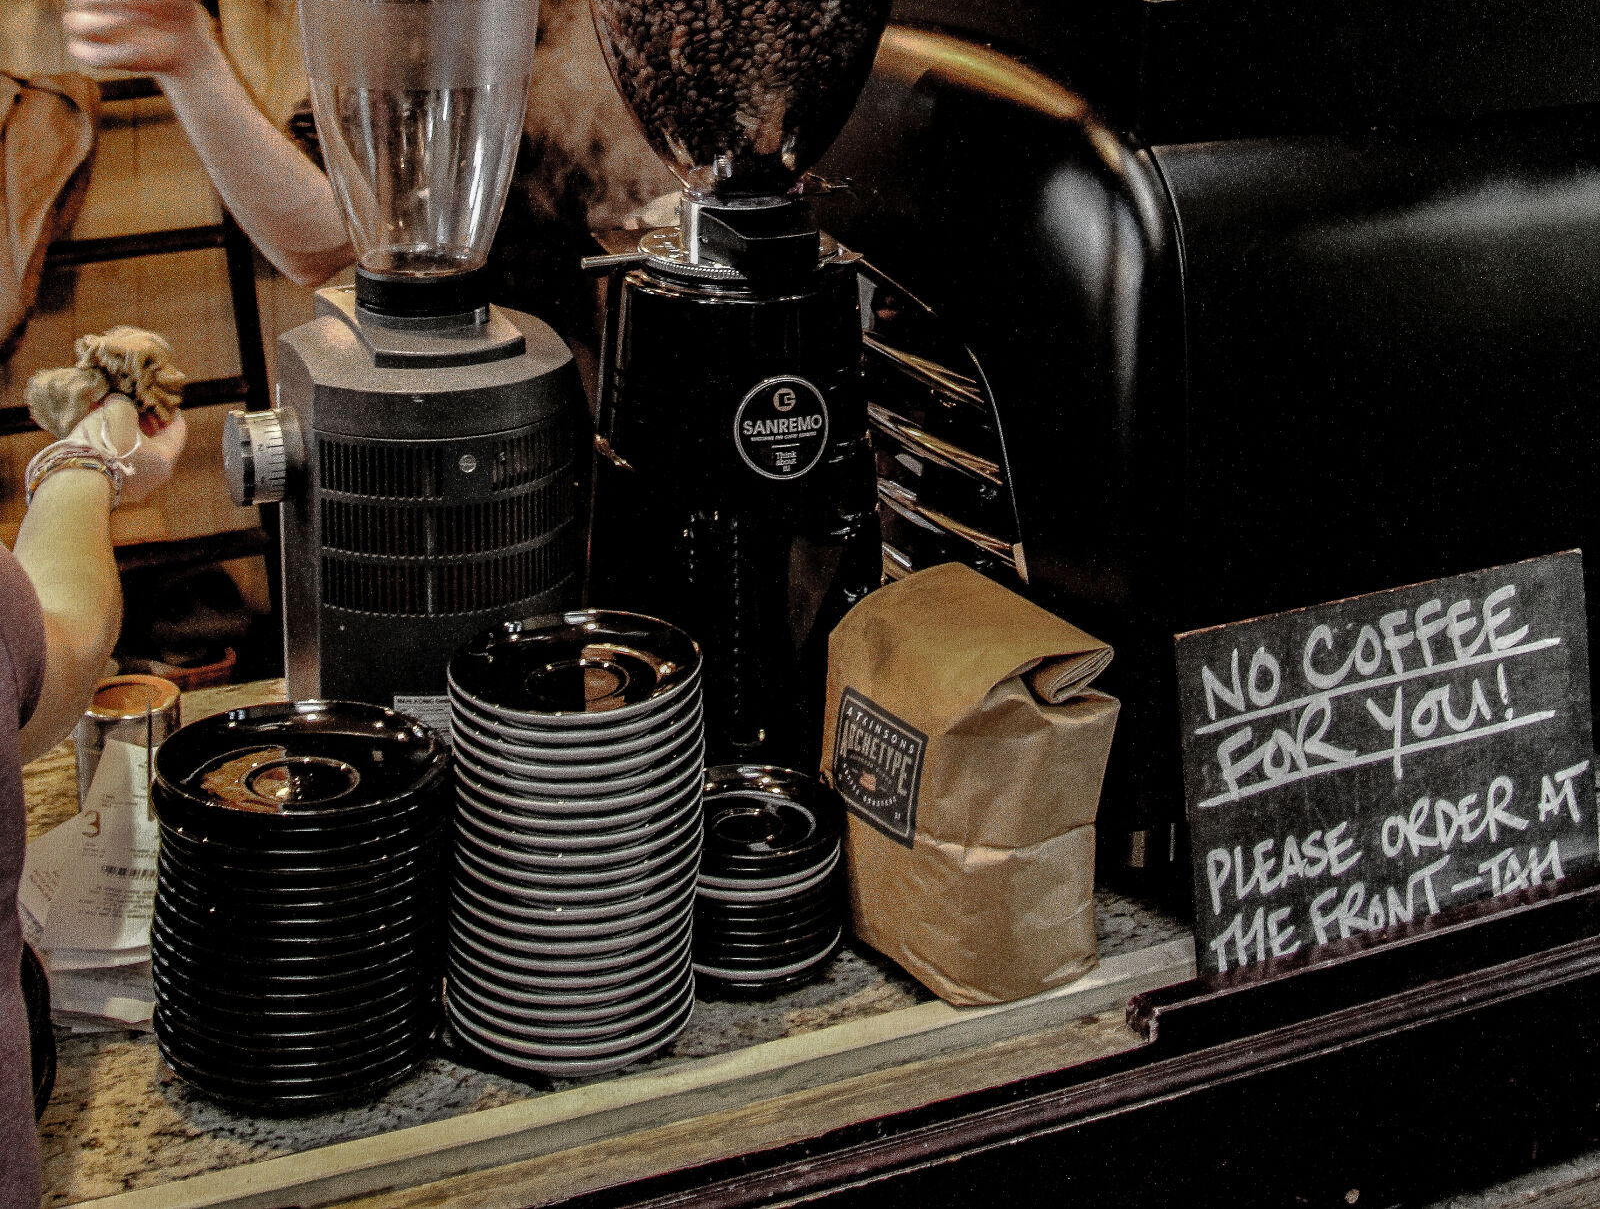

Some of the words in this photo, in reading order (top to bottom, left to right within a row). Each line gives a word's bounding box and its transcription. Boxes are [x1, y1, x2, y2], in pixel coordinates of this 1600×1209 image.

[742, 414, 823, 436] SANREMO
[1201, 646, 1281, 721] NO
[1302, 584, 1530, 690] COFFEE
[1216, 695, 1358, 800] FOR
[1366, 662, 1516, 780] YOU!
[1206, 821, 1363, 916] PLEASE
[1380, 775, 1530, 858] ORDER
[1538, 760, 1590, 824] AT
[1209, 906, 1302, 974] THE
[1308, 855, 1450, 946] FRONT
